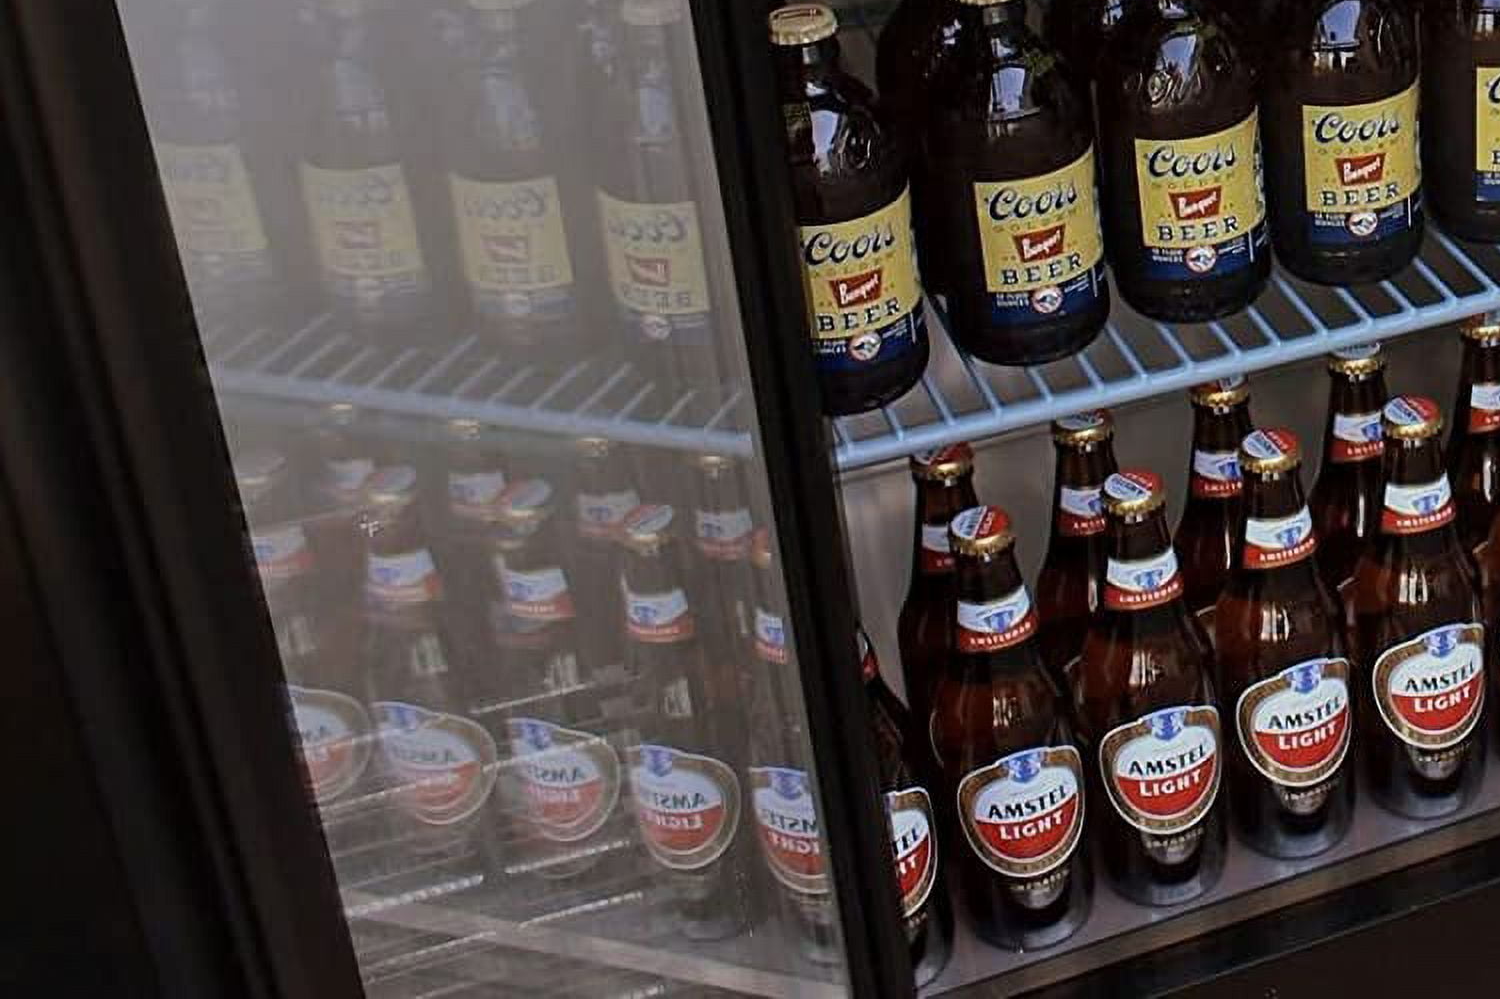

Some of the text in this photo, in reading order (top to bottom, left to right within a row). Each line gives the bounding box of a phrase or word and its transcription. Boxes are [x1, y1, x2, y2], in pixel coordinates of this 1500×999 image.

[1315, 111, 1399, 144] Coors
[1148, 142, 1235, 177] Coors
[987, 180, 1077, 221] Coors
[1321, 182, 1399, 206] BEER
[801, 223, 895, 266] Coors
[1157, 215, 1238, 241] BEER
[1000, 252, 1081, 285] BEER
[816, 297, 899, 331] BEER
[1405, 660, 1474, 693] AMSTEL
[1268, 696, 1340, 730] AMSTEL
[1414, 685, 1472, 712] LIGHT
[1279, 721, 1337, 750] LIGHT
[1129, 744, 1204, 776] AMSTEL
[1139, 769, 1201, 797] LIGHT
[988, 785, 1066, 821] AMSTEL
[892, 828, 919, 856] TEL
[1000, 811, 1065, 841] LIGHT
